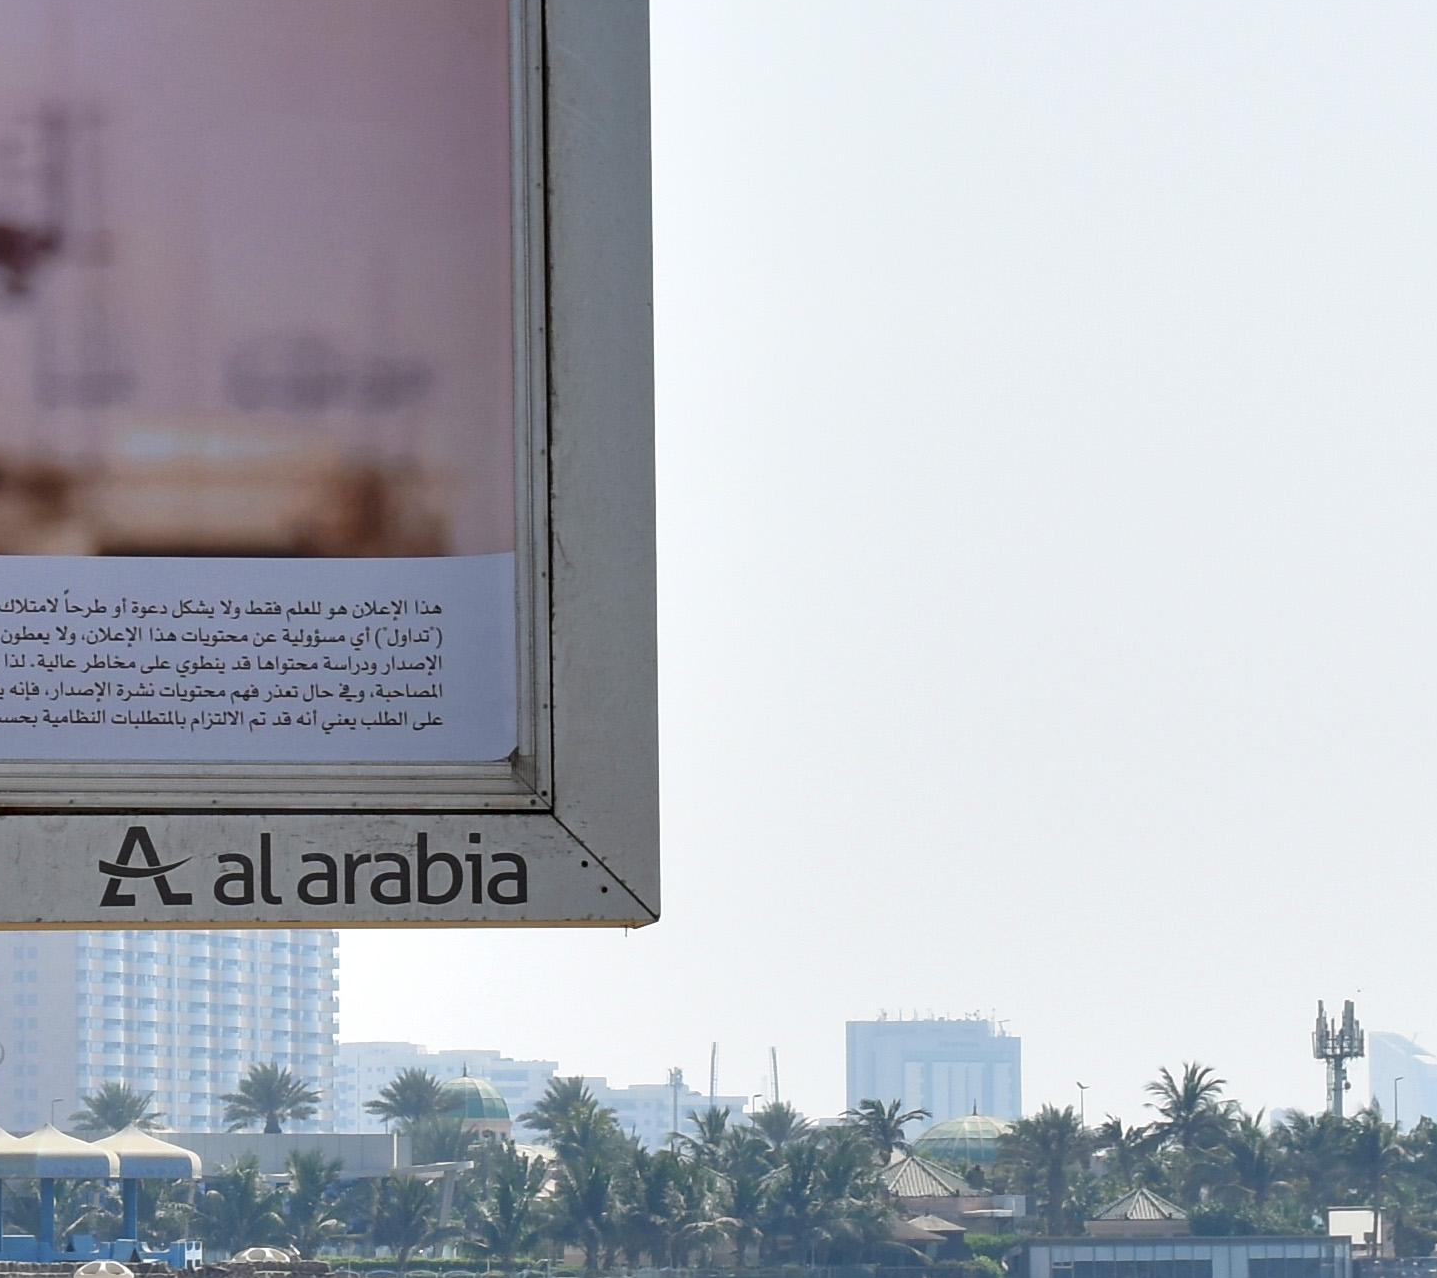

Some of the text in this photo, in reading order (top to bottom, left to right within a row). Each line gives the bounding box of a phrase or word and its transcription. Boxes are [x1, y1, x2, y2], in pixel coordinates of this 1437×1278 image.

[110, 596, 128, 619] أو
[131, 600, 168, 620] دعوة
[171, 599, 215, 620] يشكل
[219, 598, 241, 620] ولا
[244, 599, 282, 616] فقط
[285, 600, 322, 623] للعلم
[324, 604, 348, 621] هو
[351, 599, 408, 622] الإعلان
[414, 599, 443, 615] هذا
[4, 652, 26, 669] لذا
[29, 653, 78, 673] عالية.
[79, 653, 137, 674] مخاطر
[139, 654, 172, 675] على
[175, 654, 226, 679] ينطوي
[231, 655, 252, 671] قد
[256, 655, 319, 676] محتواها
[322, 655, 378, 676] ودراسة
[380, 654, 443, 677] الإصدار
[8, 680, 40, 702] فإنه
[116, 682, 156, 702] نشرة
[158, 682, 227, 703] محتويات
[229, 683, 260, 706] فهم
[262, 683, 299, 704] تعذر
[302, 682, 335, 703] حال
[338, 682, 366, 704] وفي
[297, 831, 528, 906] arabia
